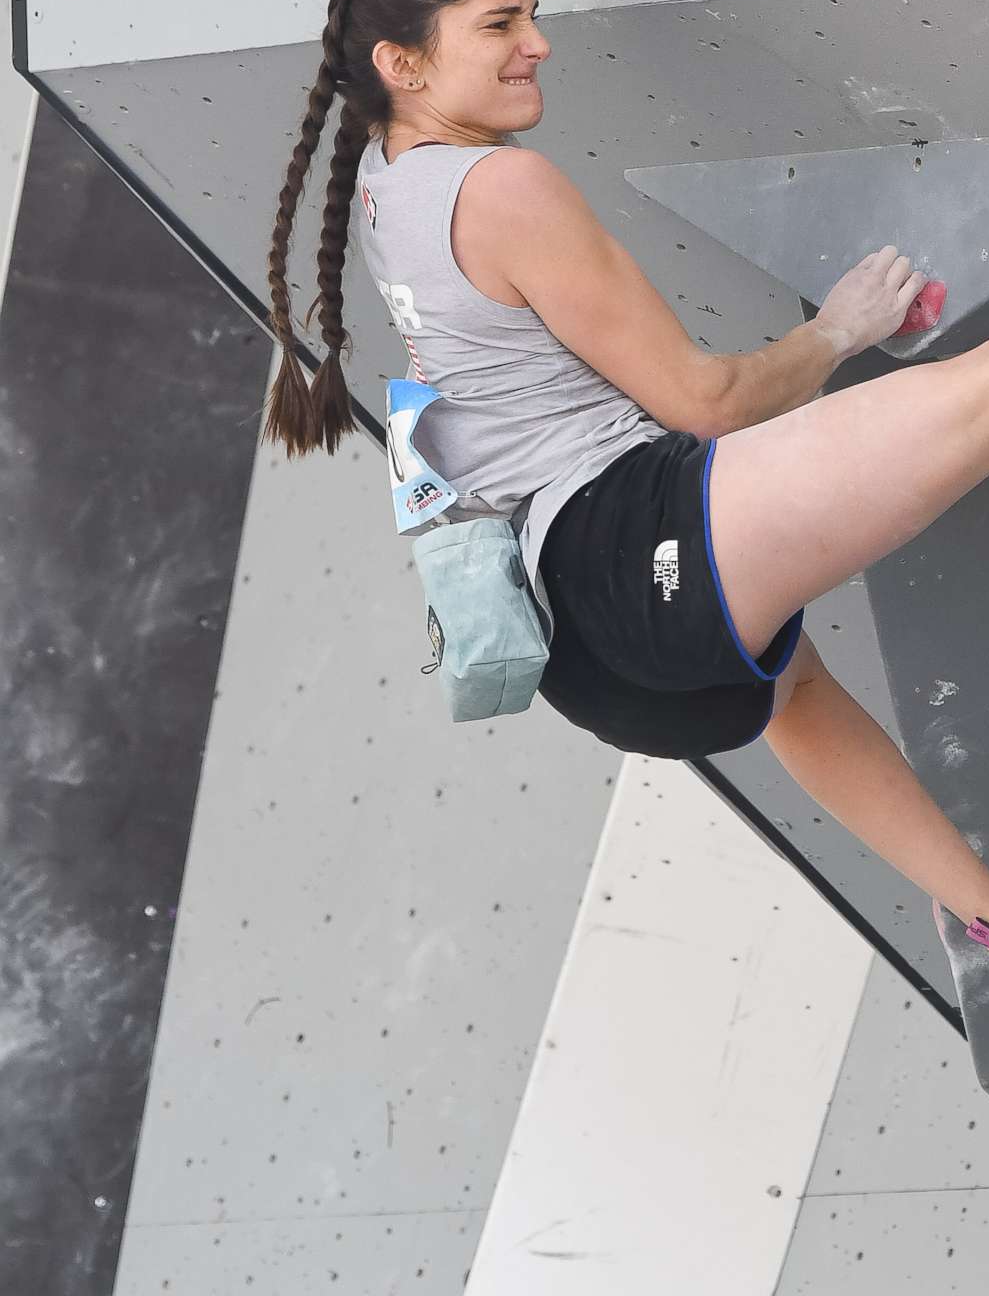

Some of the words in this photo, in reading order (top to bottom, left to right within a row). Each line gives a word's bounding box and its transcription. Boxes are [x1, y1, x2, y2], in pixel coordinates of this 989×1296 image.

[653, 561, 663, 584] THE
[662, 561, 672, 601] NORTH
[670, 561, 680, 590] FACE
